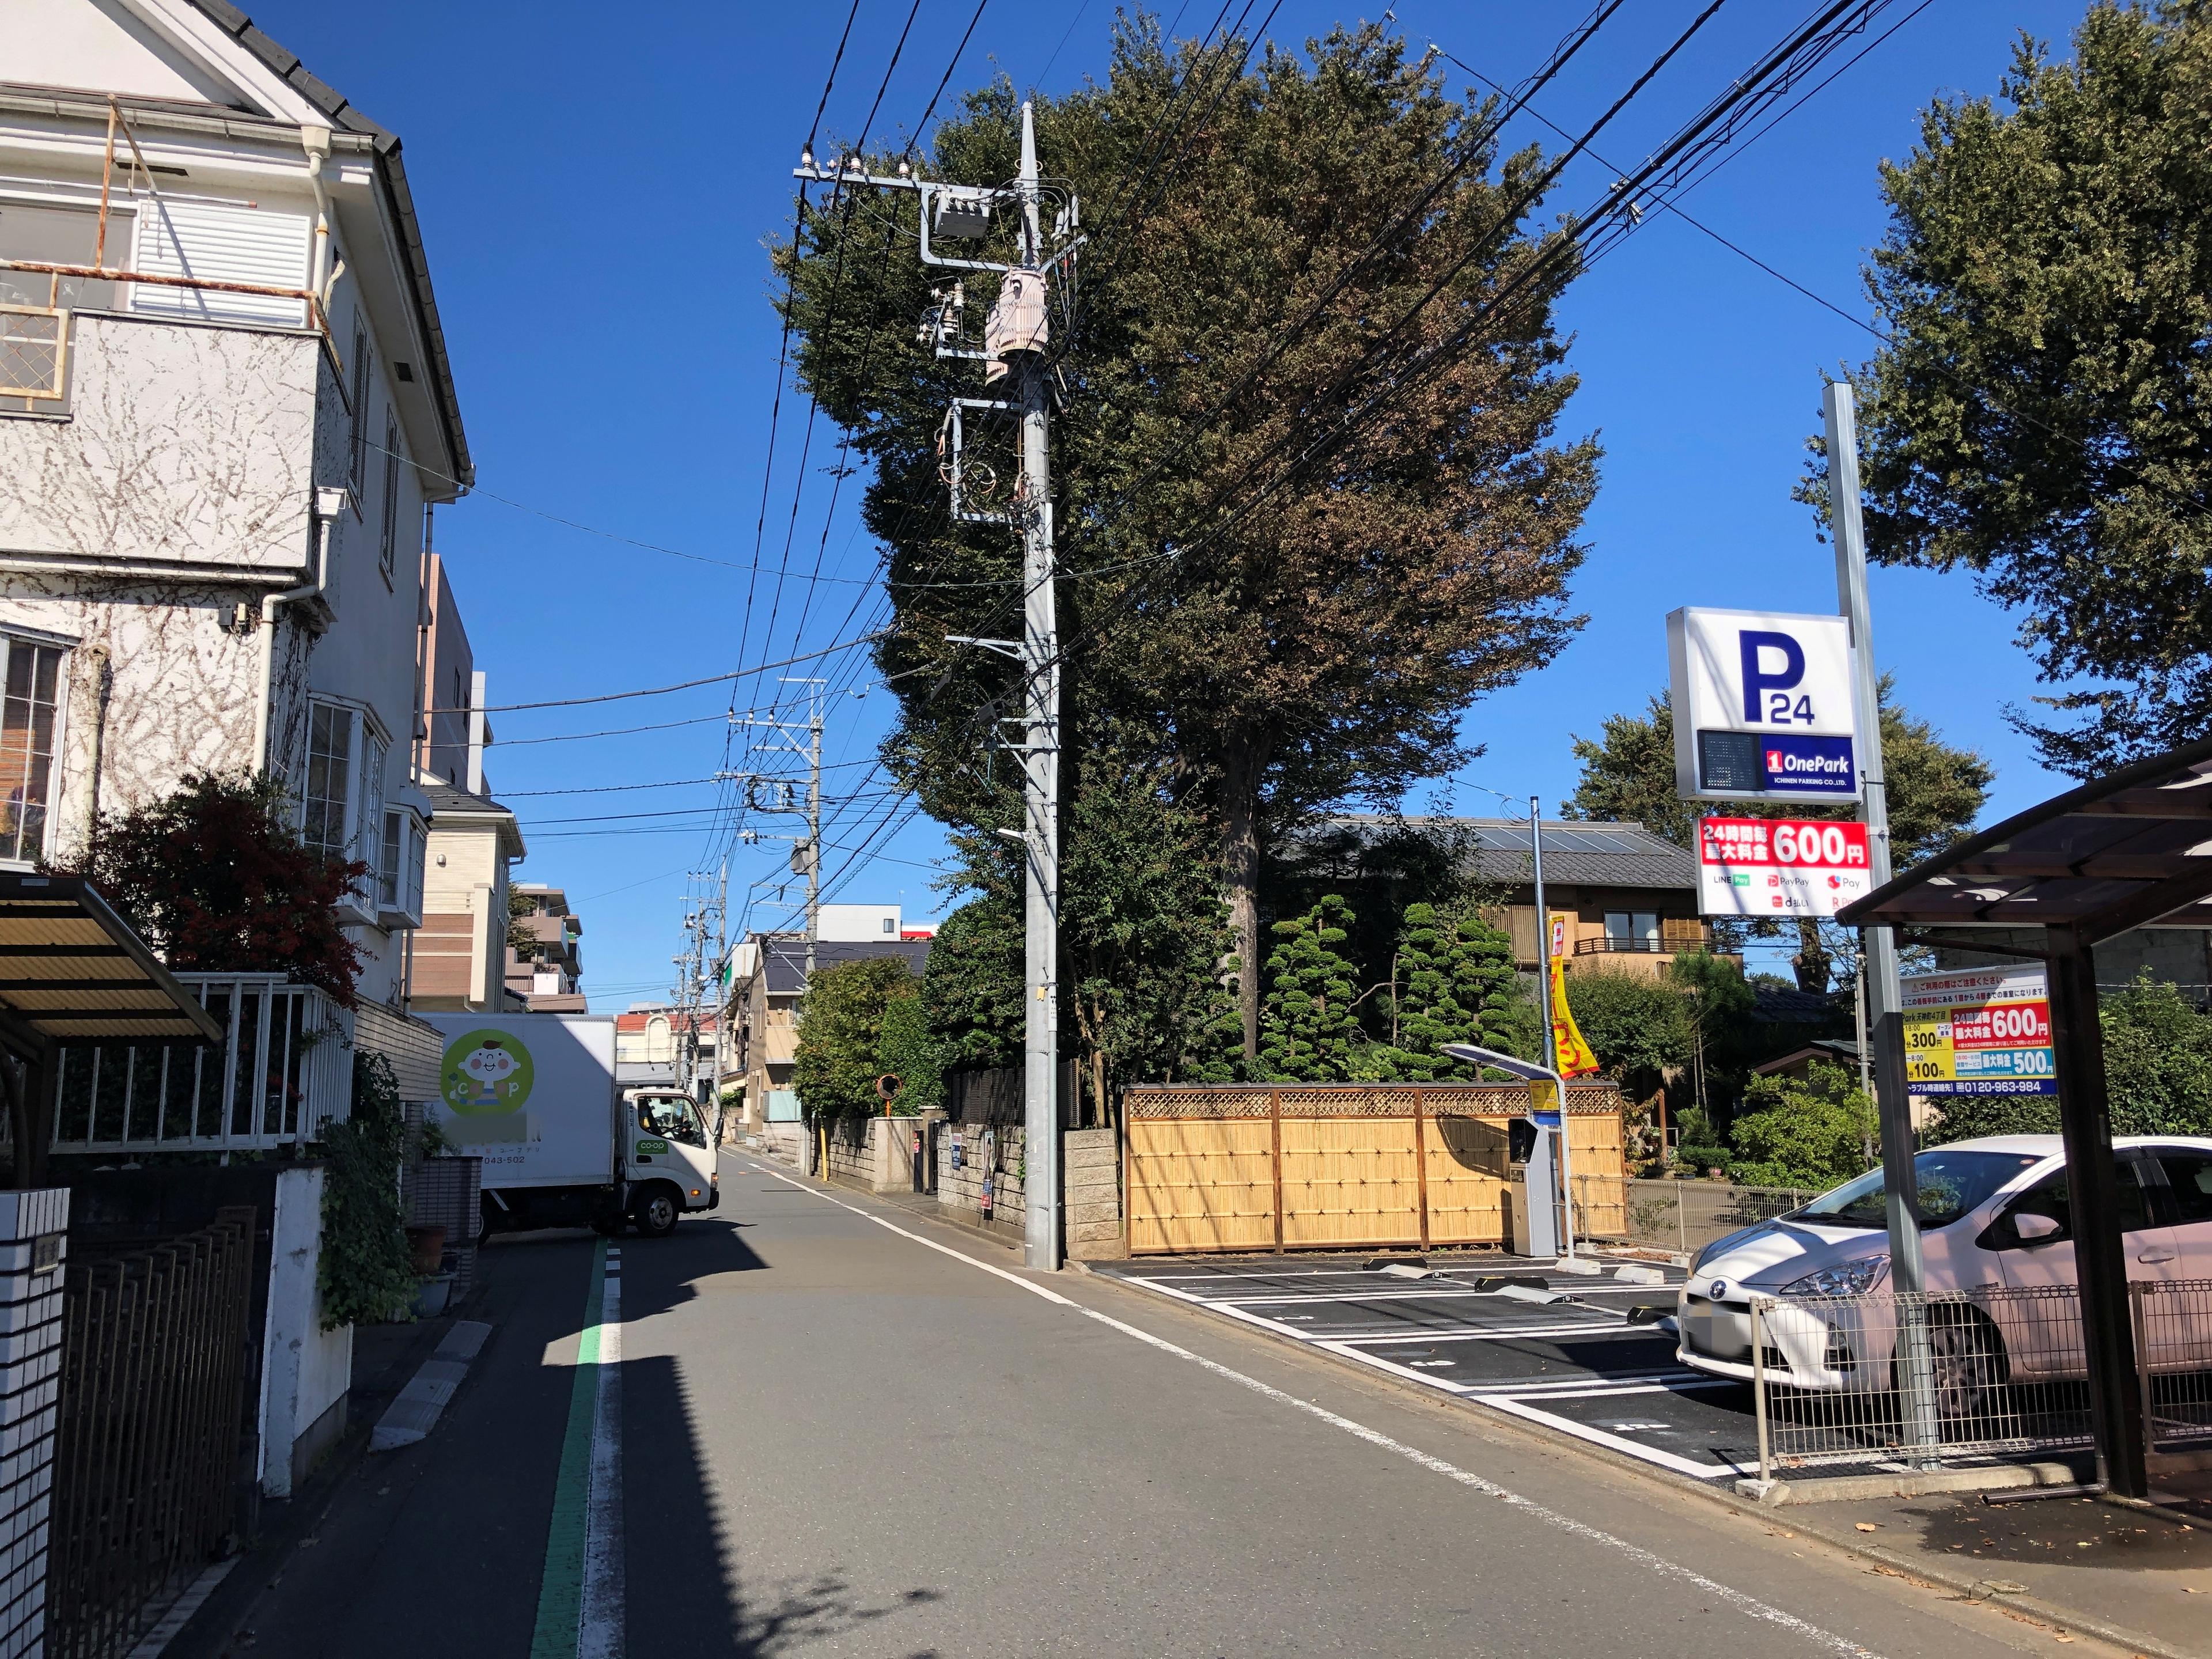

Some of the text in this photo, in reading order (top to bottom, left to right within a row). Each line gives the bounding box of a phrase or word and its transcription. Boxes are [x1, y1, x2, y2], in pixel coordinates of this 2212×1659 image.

[1738, 630, 1805, 722] P
[1770, 694, 1815, 725] 24
[1784, 755, 1849, 773] OnePark
[1703, 825, 1767, 843] 24時間毎
[1706, 843, 1768, 861] 最大料金
[1774, 825, 1864, 864] 600円
[1734, 876, 1748, 884] Pay
[1780, 877, 1809, 887] PayPay
[1843, 878, 1860, 889] Pay
[1785, 896, 1809, 907] d払い
[1953, 1012, 1990, 1025] 24時間毎
[1993, 1008, 2048, 1038] 600円
[1955, 1026, 1991, 1040] 最大料金
[1983, 1053, 2012, 1069] 最大料金
[2013, 1051, 2053, 1074] 500円
[1964, 1081, 2041, 1093] 0120-963-984
